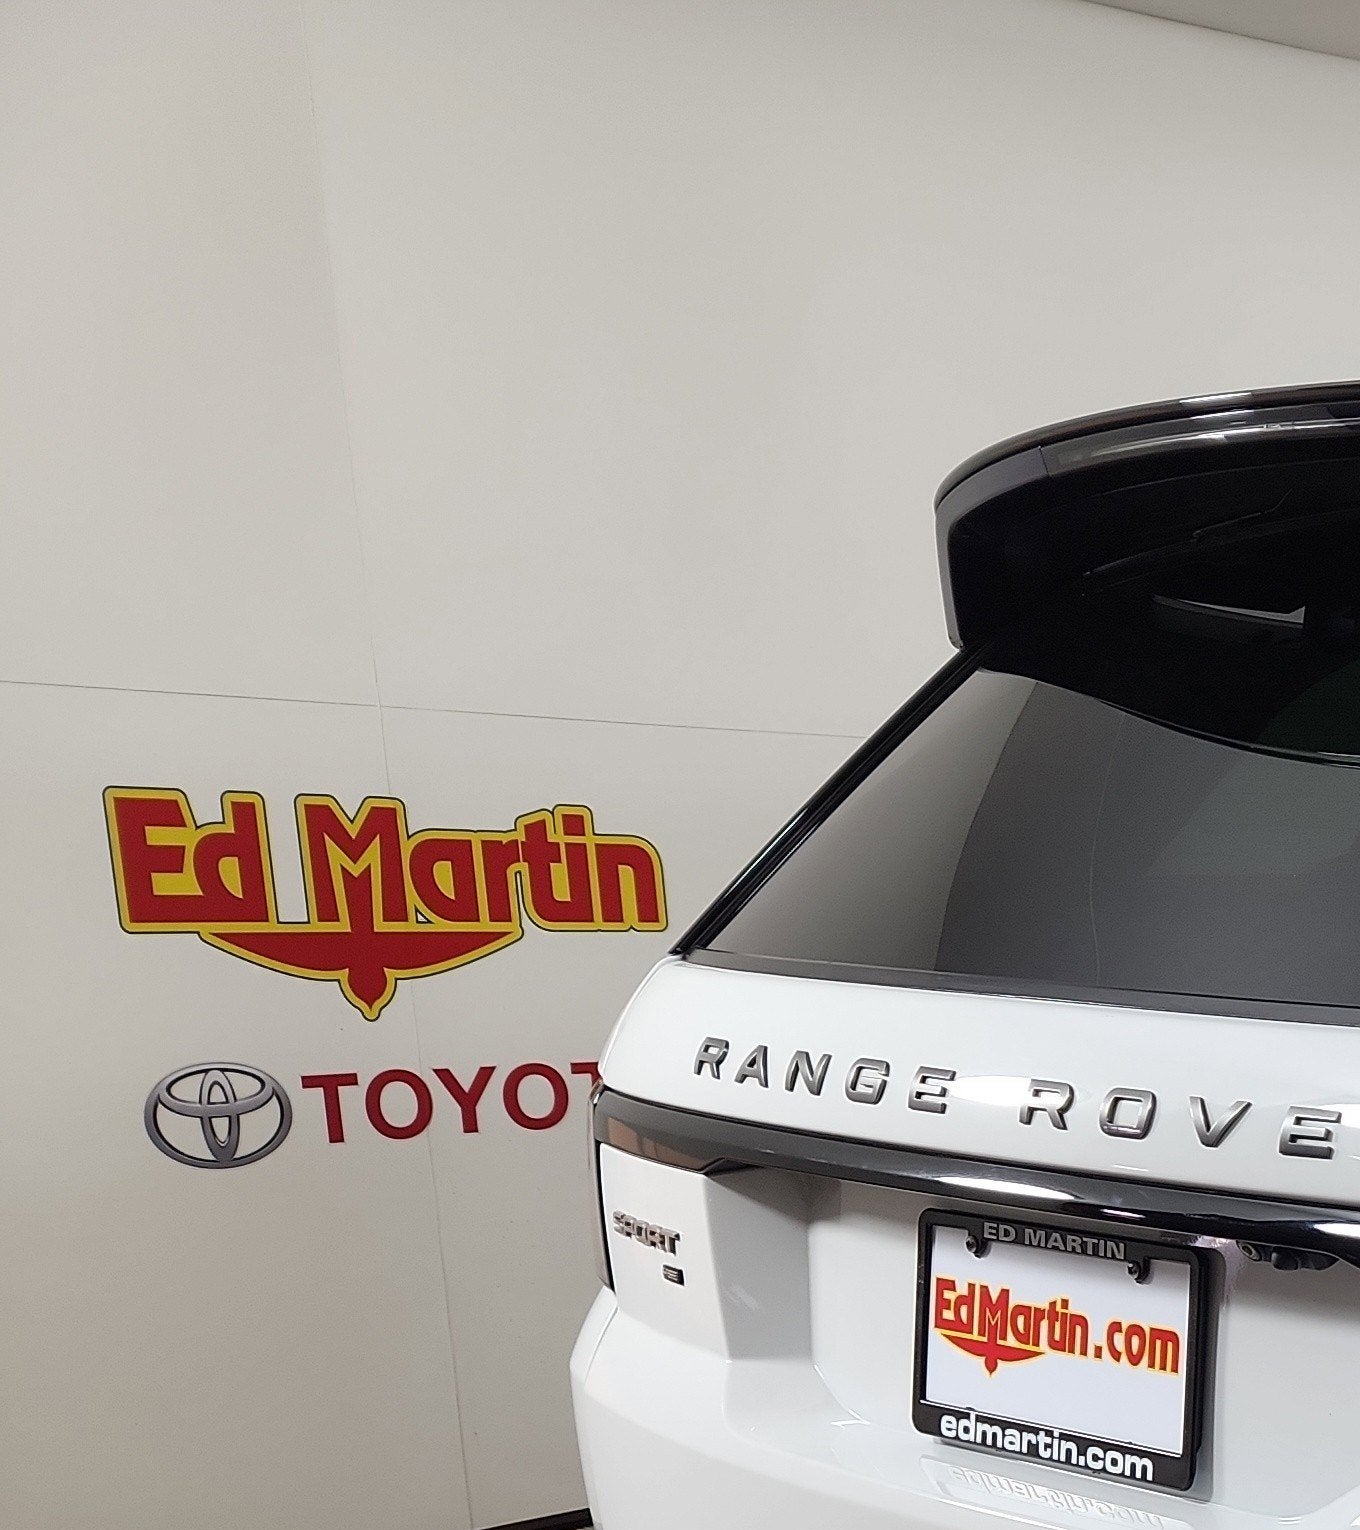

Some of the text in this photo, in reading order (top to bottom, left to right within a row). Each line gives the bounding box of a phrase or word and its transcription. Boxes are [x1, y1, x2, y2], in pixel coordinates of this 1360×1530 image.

[104, 787, 667, 932] Ed Martin
[694, 1036, 957, 1115] RANGE
[612, 1209, 681, 1256] SPORT
[983, 1221, 1126, 1260] ED MARTIN
[940, 1411, 1154, 1481] edmartin.com
